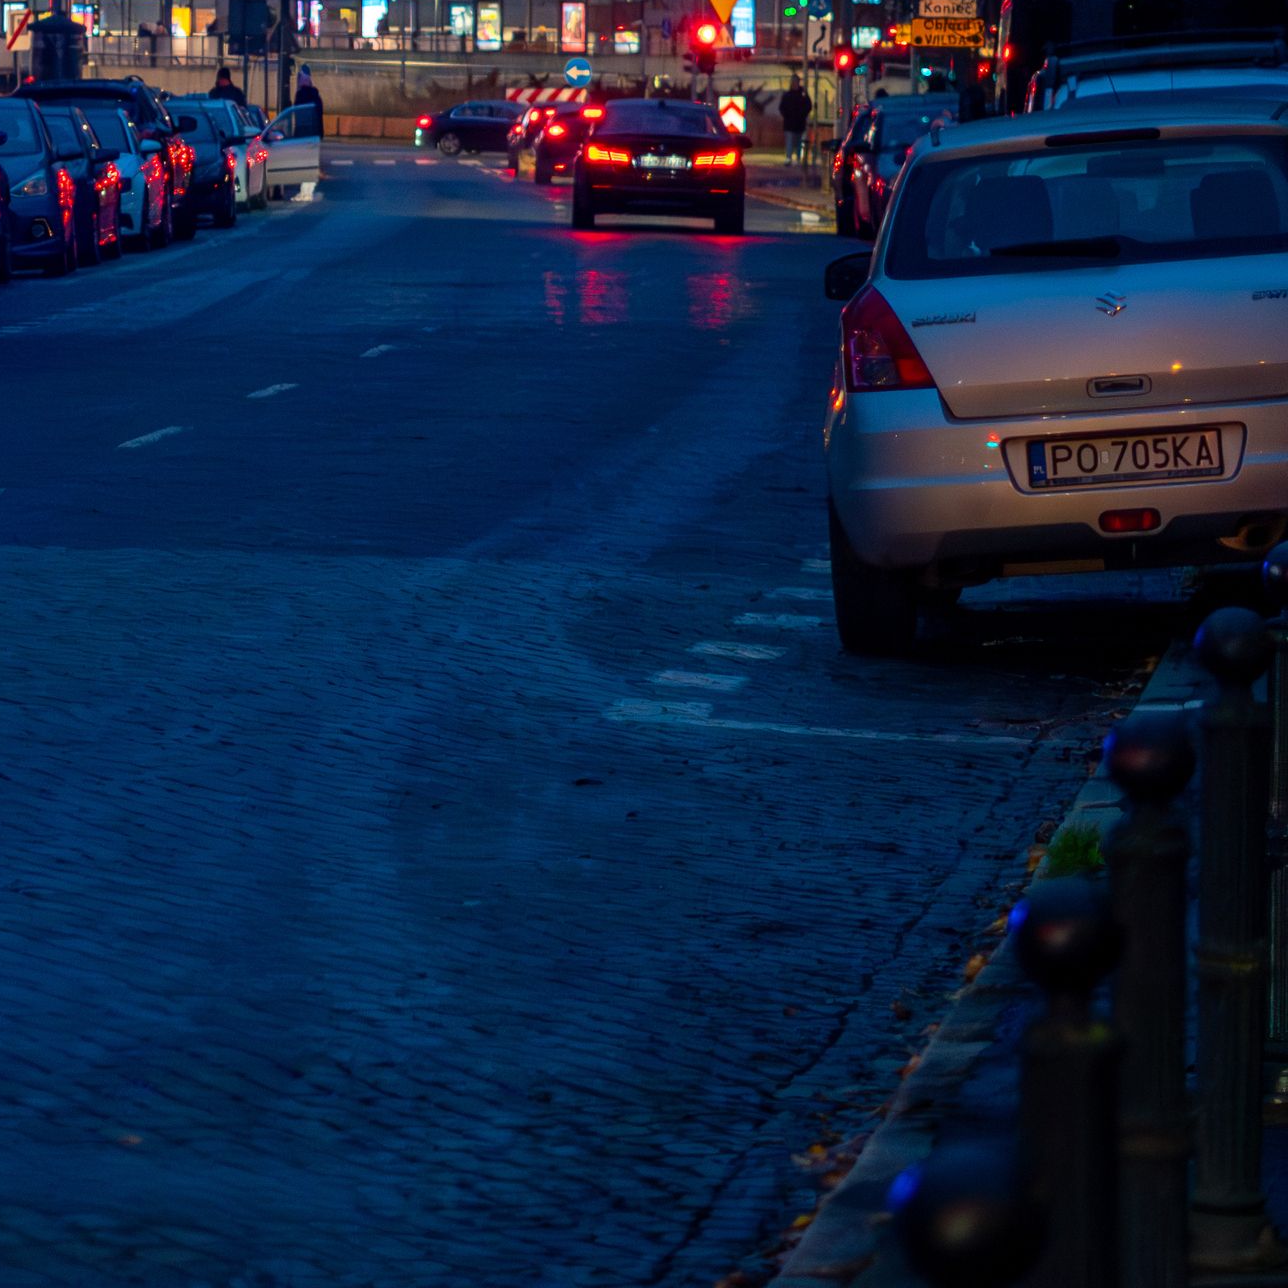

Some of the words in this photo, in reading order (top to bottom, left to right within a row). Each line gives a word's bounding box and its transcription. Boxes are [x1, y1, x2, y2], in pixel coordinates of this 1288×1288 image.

[924, 1, 971, 14] Koniec
[1051, 443, 1098, 476] PO
[1110, 434, 1214, 472] 705KA
